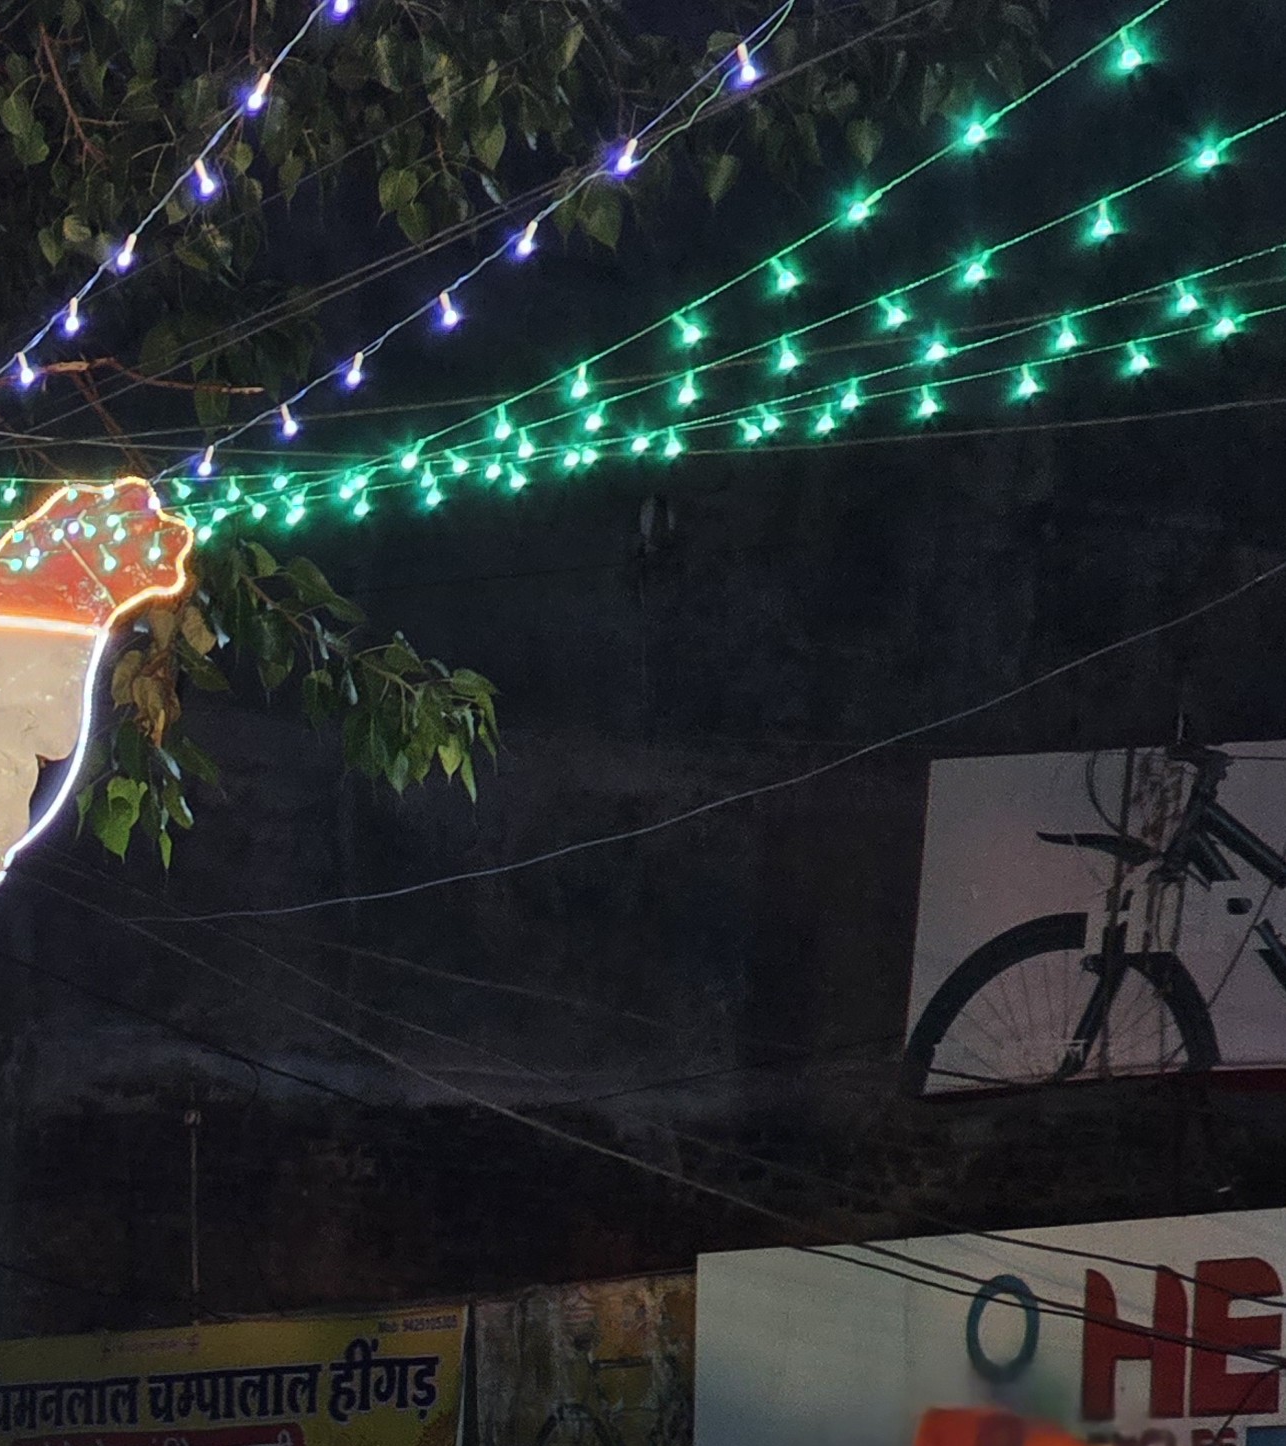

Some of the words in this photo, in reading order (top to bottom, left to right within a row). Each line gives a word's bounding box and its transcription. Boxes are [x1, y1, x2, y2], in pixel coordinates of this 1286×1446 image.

[147, 1363, 320, 1420] चम्पालाल
[328, 1339, 439, 1421] हींगड़
[1082, 1257, 1283, 1421] HE
